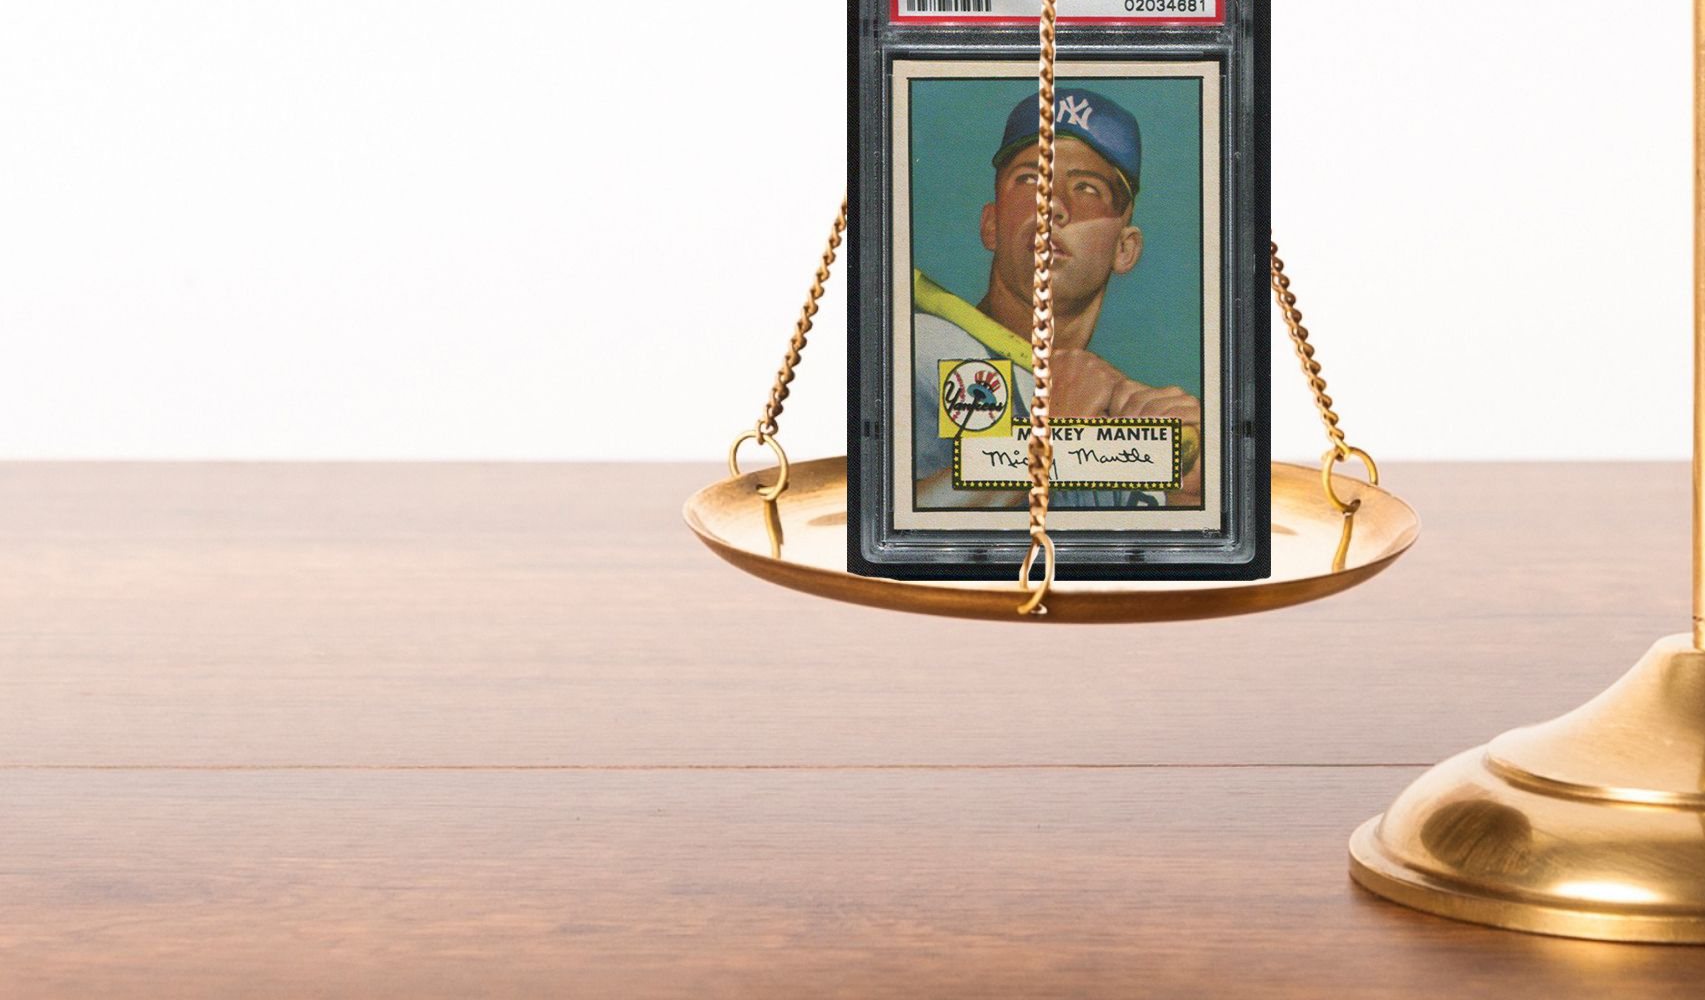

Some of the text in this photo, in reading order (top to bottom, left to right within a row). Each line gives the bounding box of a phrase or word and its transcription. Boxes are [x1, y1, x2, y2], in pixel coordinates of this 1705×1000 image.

[1017, 427, 1168, 442] MKEY MANTLE
[1068, 447, 1154, 465] Mantle
